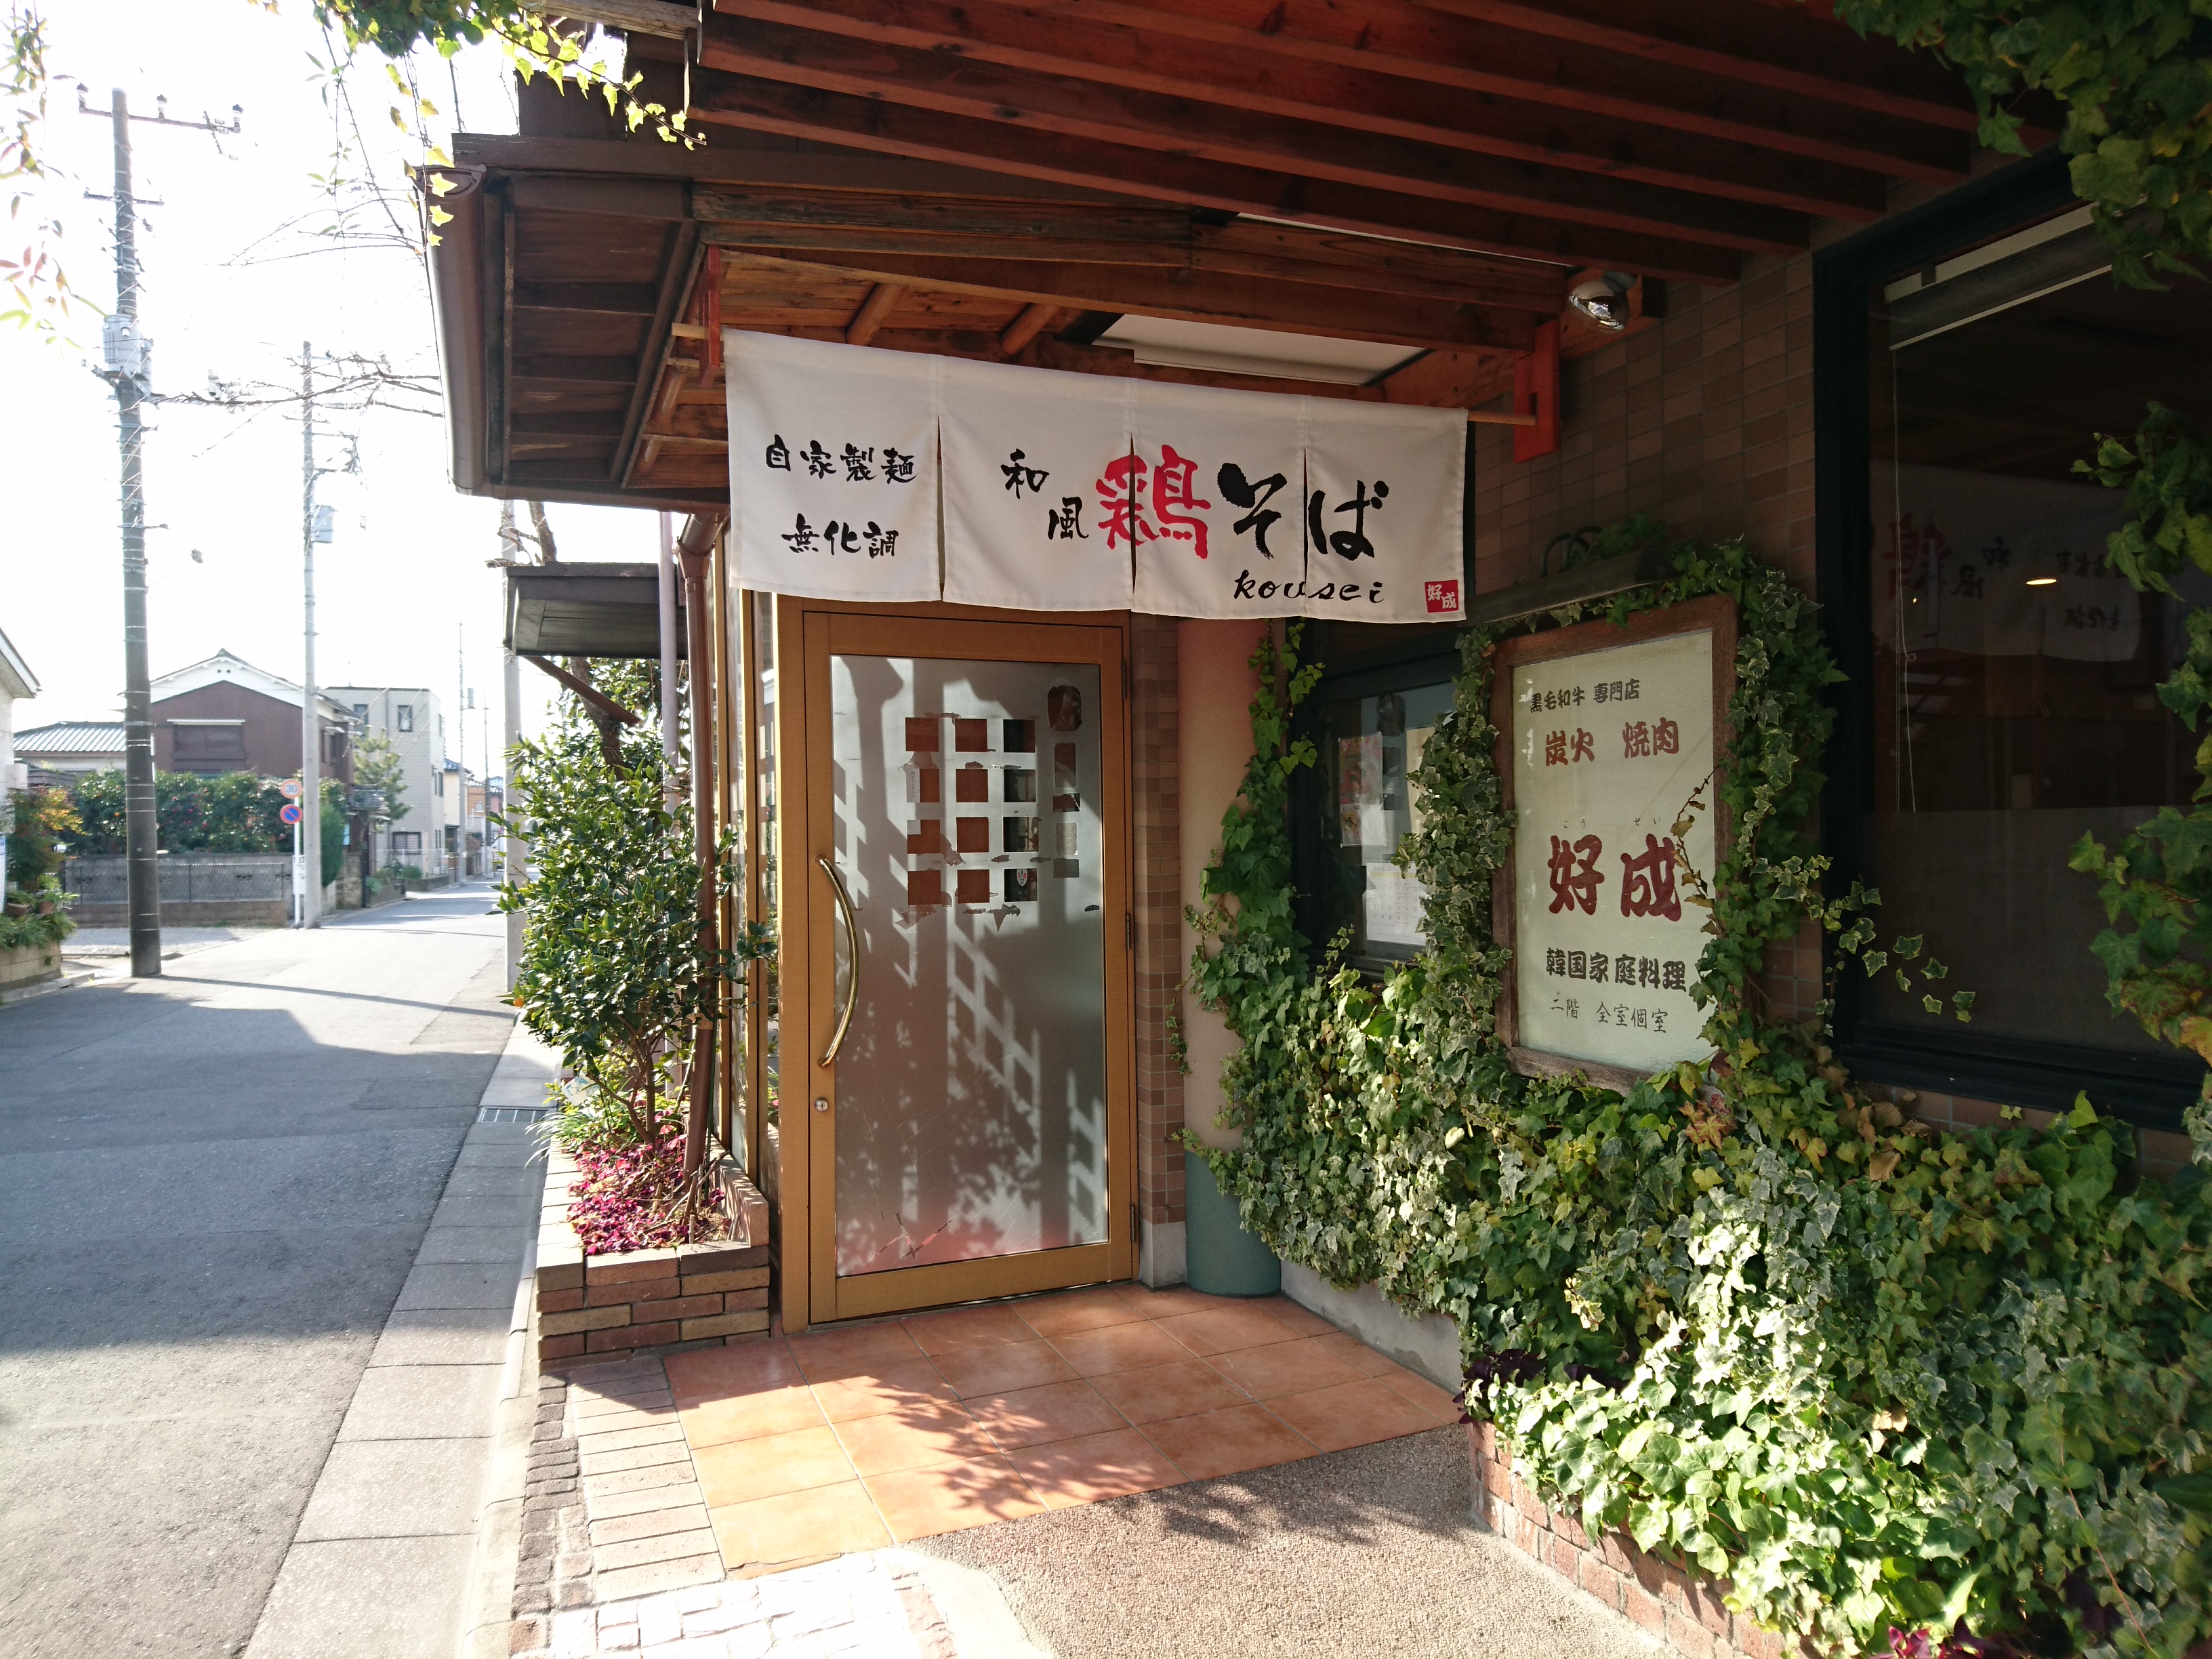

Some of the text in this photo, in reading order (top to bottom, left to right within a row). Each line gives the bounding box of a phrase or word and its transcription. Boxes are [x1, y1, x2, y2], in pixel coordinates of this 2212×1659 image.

[766, 434, 919, 485] 自家製麺
[781, 513, 899, 559] 無化調
[1233, 569, 1385, 604] kousei
[1427, 583, 1458, 609] 好成
[1530, 678, 1640, 714] 黒毛和牛 専門店
[1545, 717, 1679, 766] 炭火 焼肉
[285, 784, 298, 794] 30
[1547, 834, 1682, 922] 好成
[1546, 947, 1687, 992] 韓国家庭料理
[1551, 998, 1668, 1033] 二階 全室個室
